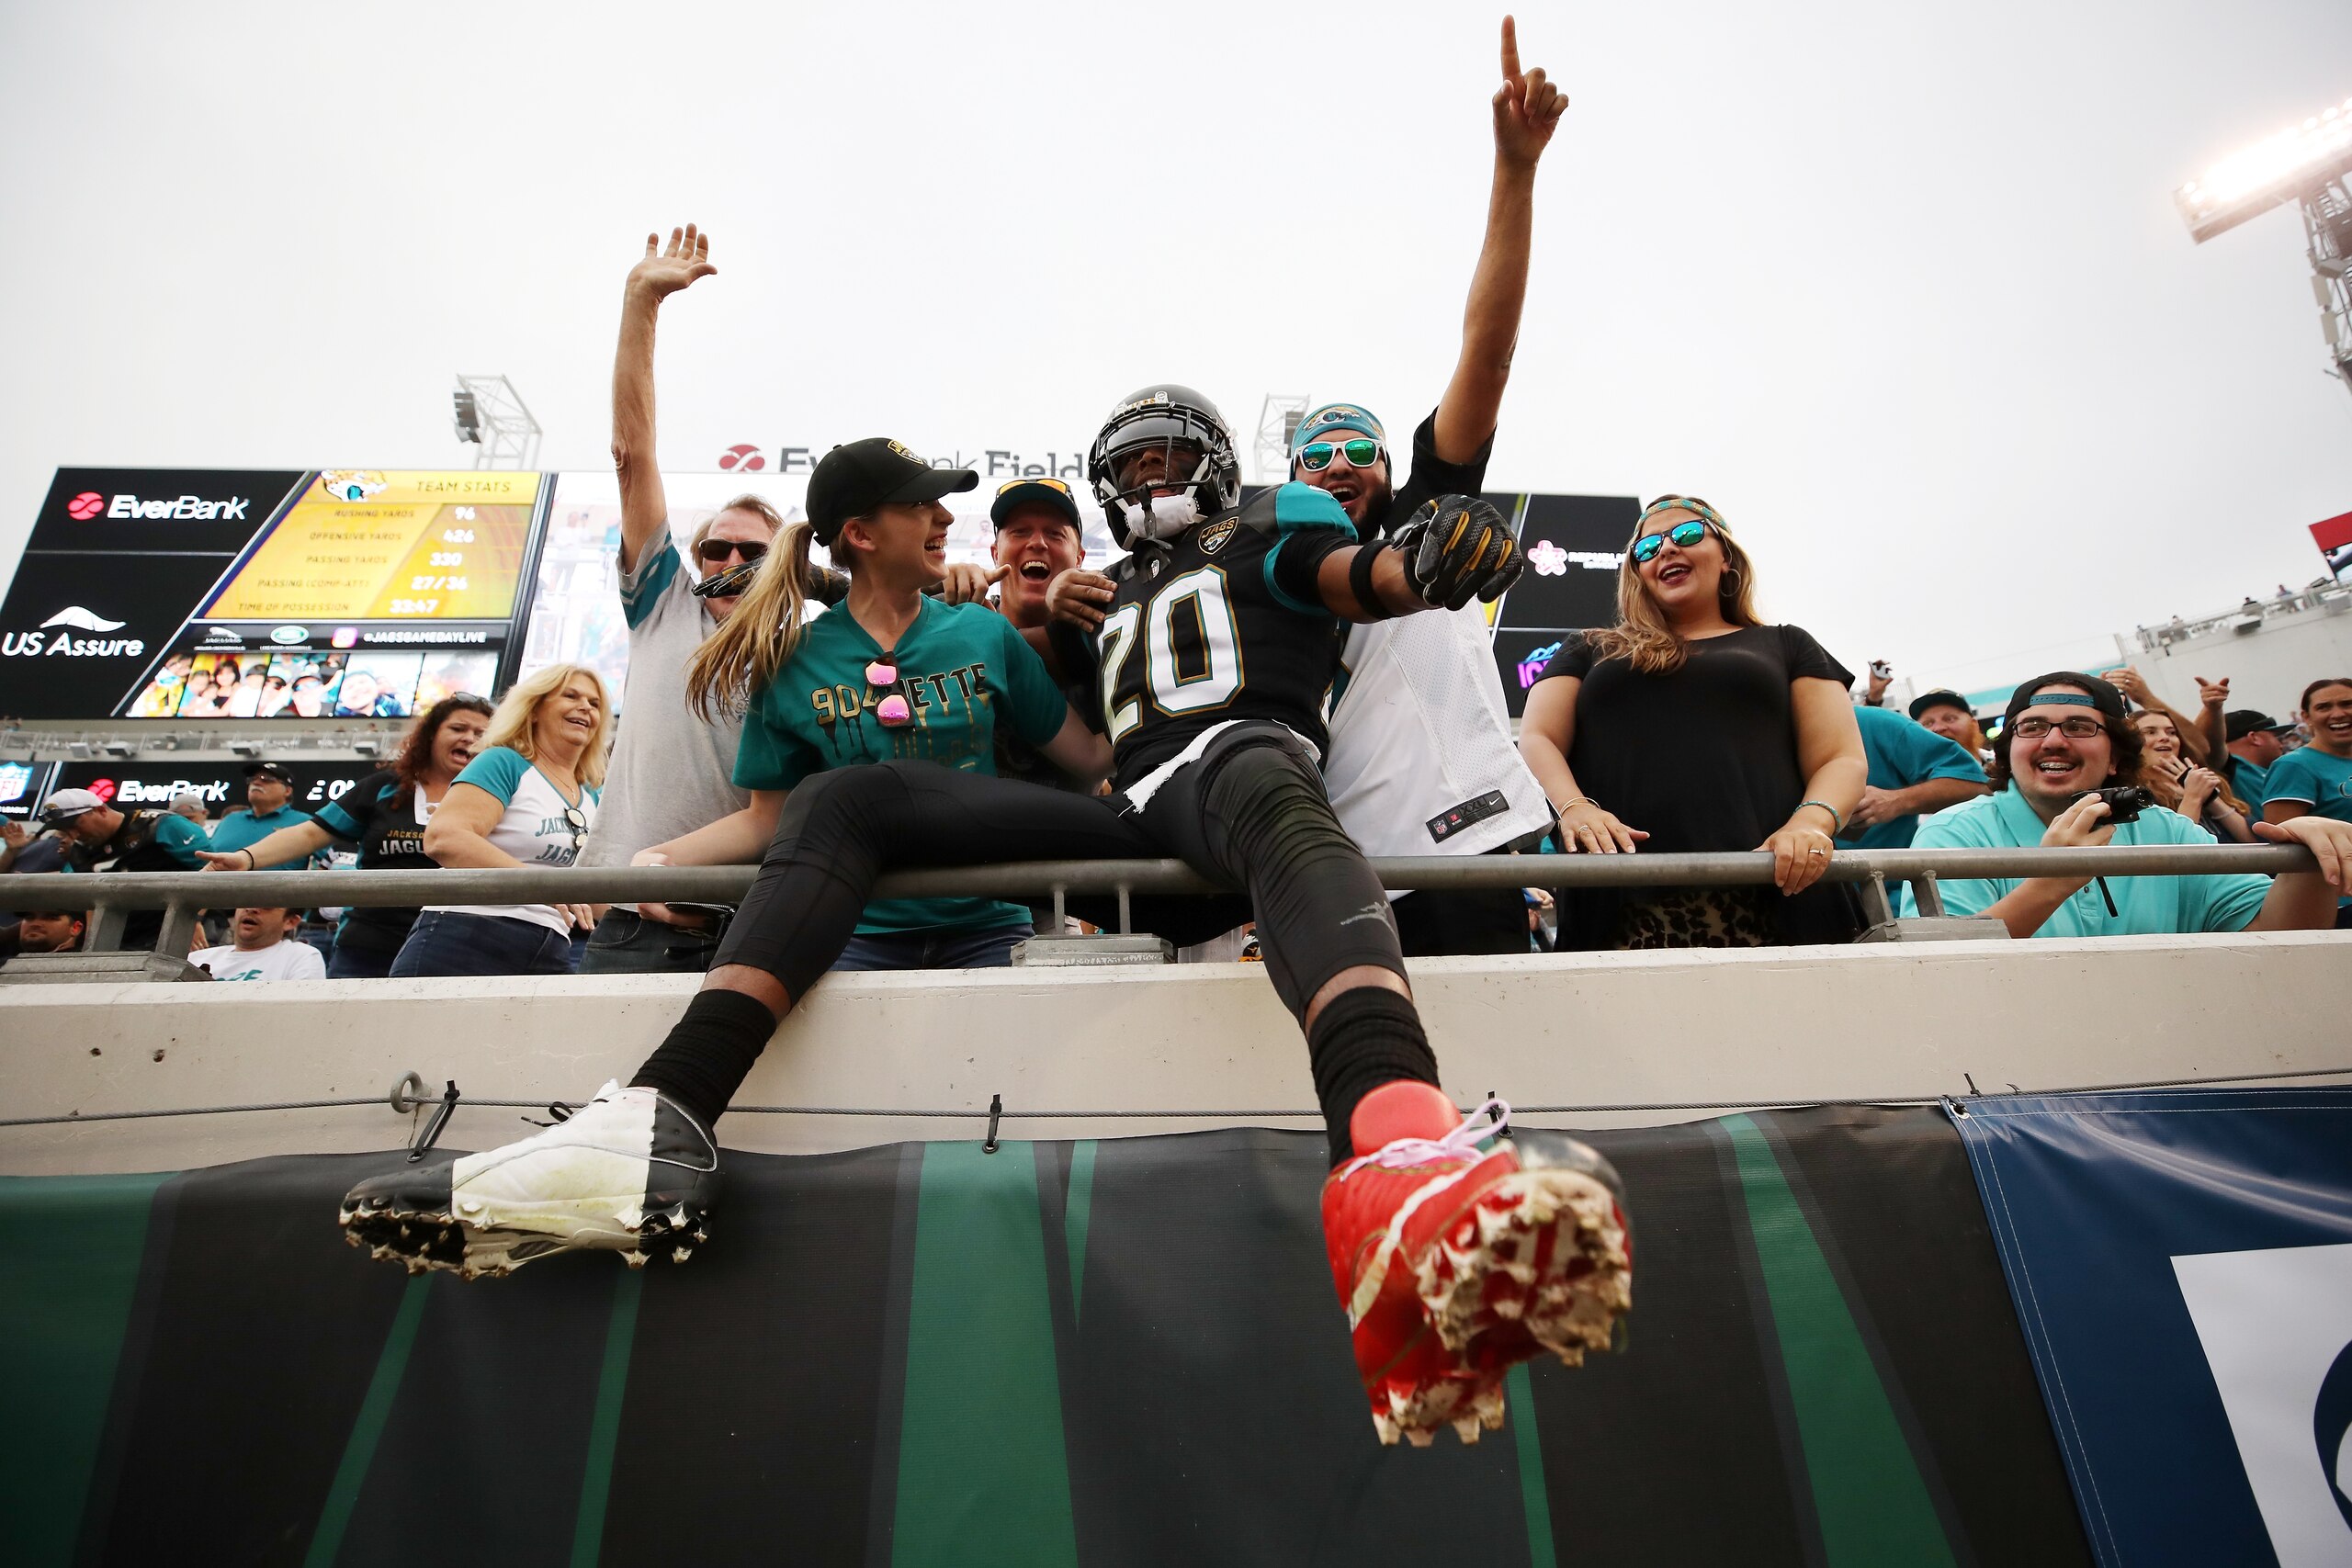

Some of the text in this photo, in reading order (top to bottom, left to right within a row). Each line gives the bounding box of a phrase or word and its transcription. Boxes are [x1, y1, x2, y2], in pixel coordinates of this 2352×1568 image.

[985, 449, 1083, 478] Field
[416, 480, 511, 493] TEAM STATS
[107, 494, 249, 521] EverBank
[334, 509, 414, 518] RUSHING YARDS
[454, 506, 477, 521] 96
[309, 532, 402, 541] OFFENSIVE YARDS
[443, 529, 476, 544] 426
[1201, 519, 1235, 539] JAGS
[306, 555, 388, 564] PASSING YARDS
[257, 579, 303, 588] PASSING
[238, 602, 350, 612] TIME OF POSSESSION
[1, 631, 145, 657] US Assure
[1097, 563, 1245, 749] 20
[117, 779, 231, 802] EverBank
[1459, 799, 1487, 816] XXL
